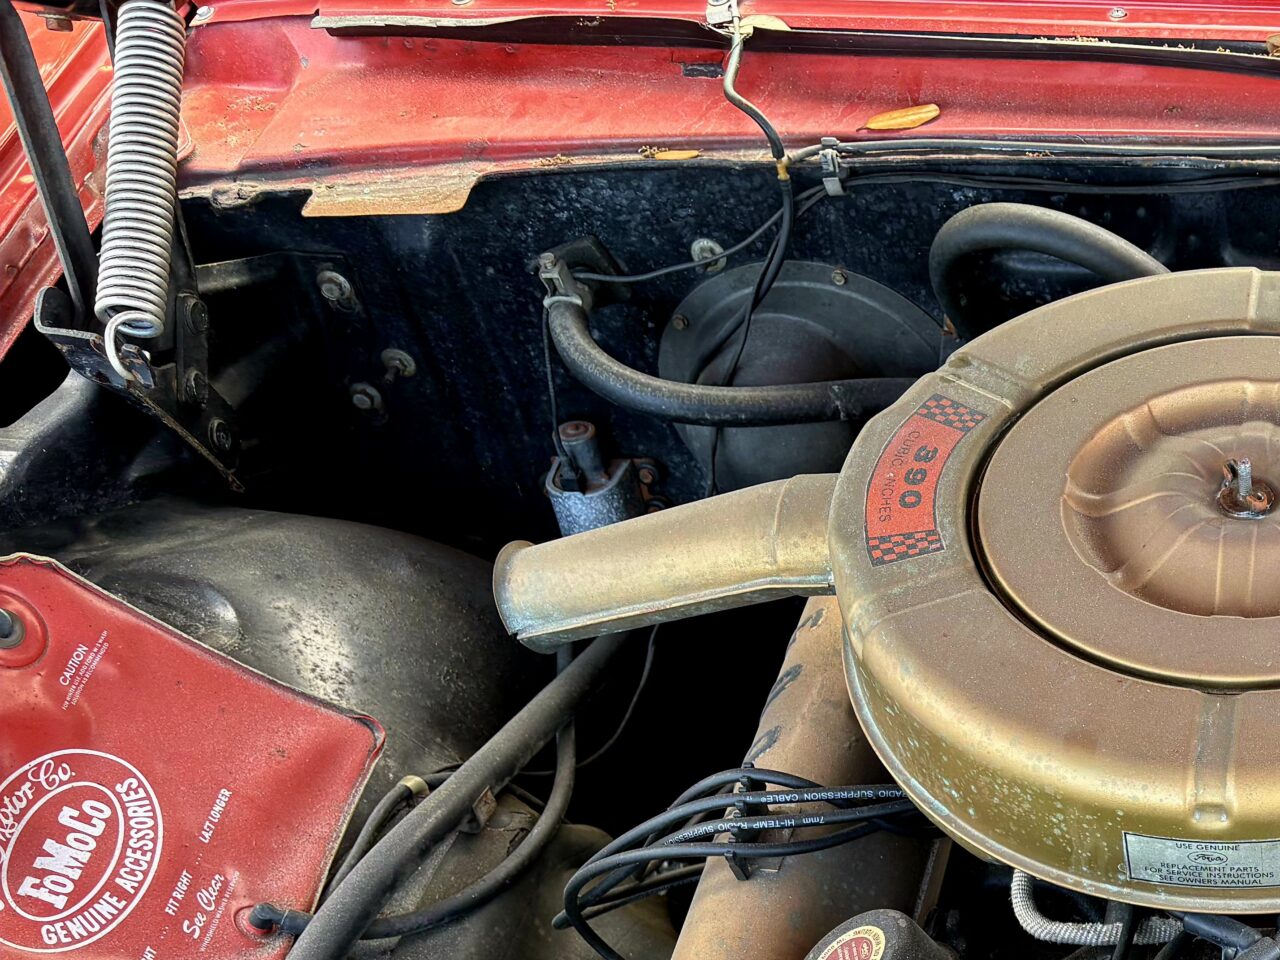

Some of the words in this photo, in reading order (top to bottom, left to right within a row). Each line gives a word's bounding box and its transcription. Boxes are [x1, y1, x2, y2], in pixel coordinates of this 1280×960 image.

[891, 430, 921, 467] CUBIC
[879, 472, 897, 523] NCHES
[898, 445, 939, 509] 390
[57, 642, 88, 687] CAUTION
[0, 782, 35, 842] otor
[28, 759, 76, 790] Co.
[804, 790, 872, 799] SUPPRESSION
[753, 819, 795, 830] HI-TEMP
[803, 816, 825, 825] 7mm
[17, 796, 113, 910] FoMoCo
[42, 890, 127, 946] GENUINE
[115, 777, 154, 894] ACCESSORIES
[165, 896, 180, 916] FIT
[173, 870, 194, 902] RIGHT
[209, 787, 233, 823] LONGER
[1175, 842, 1193, 850] USE
[1159, 874, 1174, 882] SEE
[1177, 876, 1218, 885] OWNERS
[1160, 862, 1227, 872] REPLACEMENT
[1166, 869, 1202, 877] SERVICE
[1206, 871, 1275, 879] INSTRUCTIONS
[182, 910, 203, 940] See
[198, 872, 226, 911] Clear
